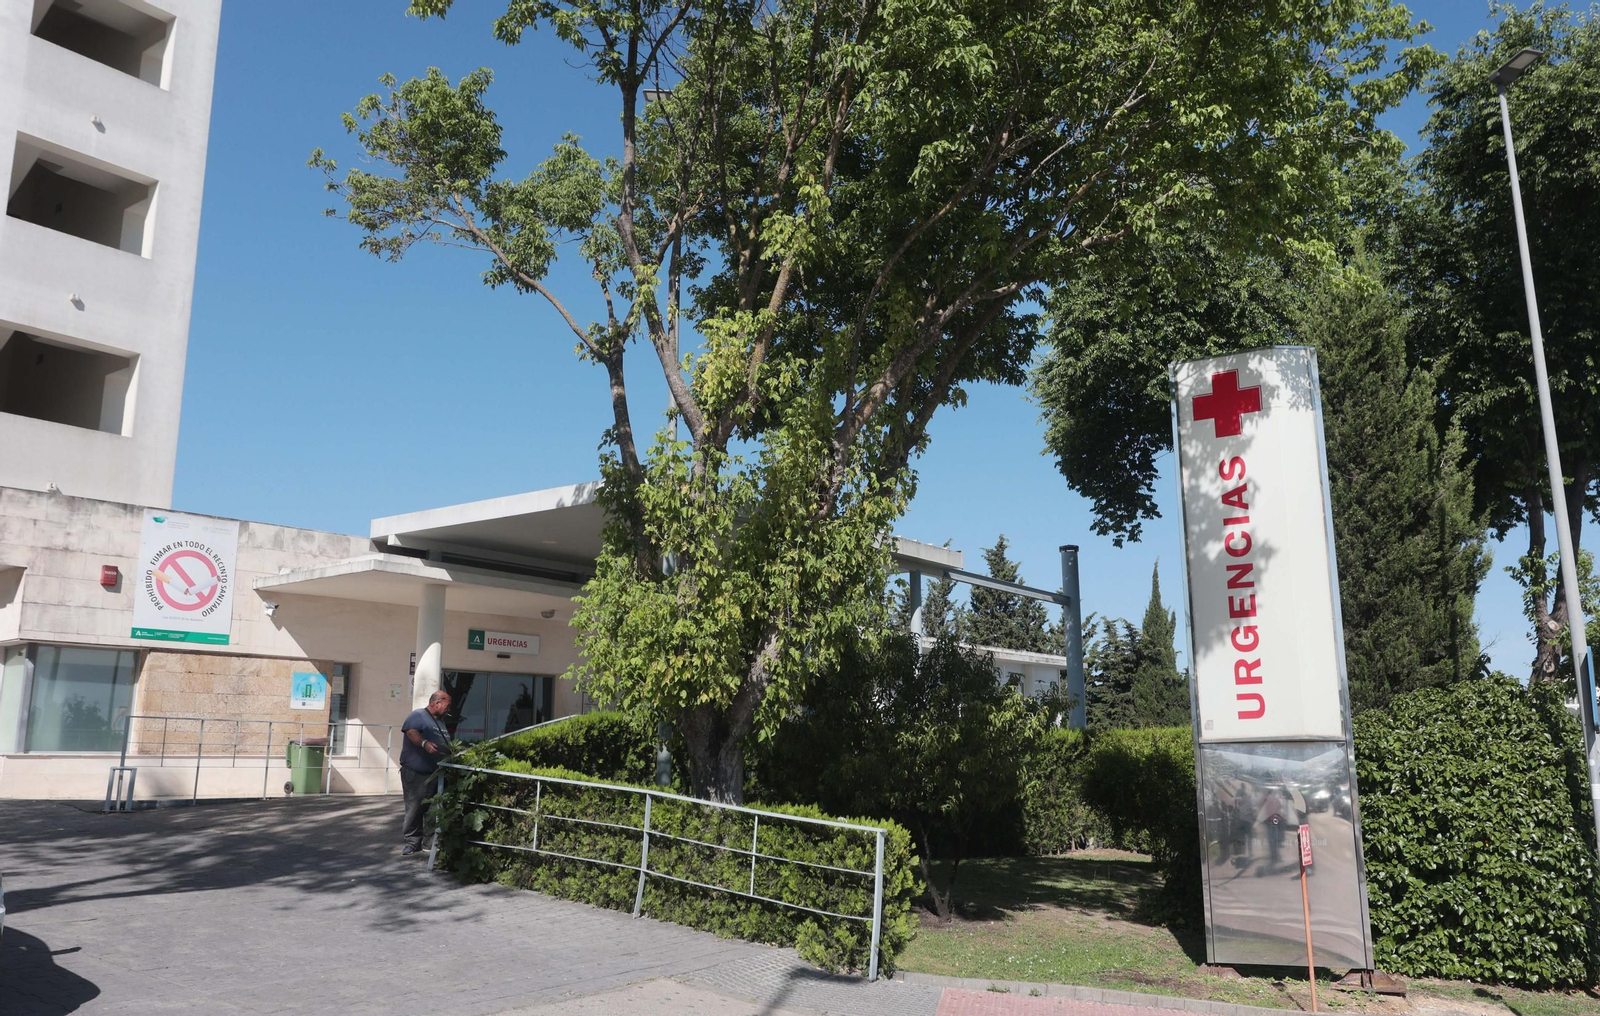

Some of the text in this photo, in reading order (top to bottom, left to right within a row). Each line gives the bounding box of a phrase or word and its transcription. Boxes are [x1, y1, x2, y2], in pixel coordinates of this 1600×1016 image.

[145, 540, 228, 618] PROHIBIDO FUMAR EN TODO EL RECINTO SANITARIO
[1218, 454, 1266, 721] URGENCIAS
[487, 637, 528, 648] URGENCIAS
